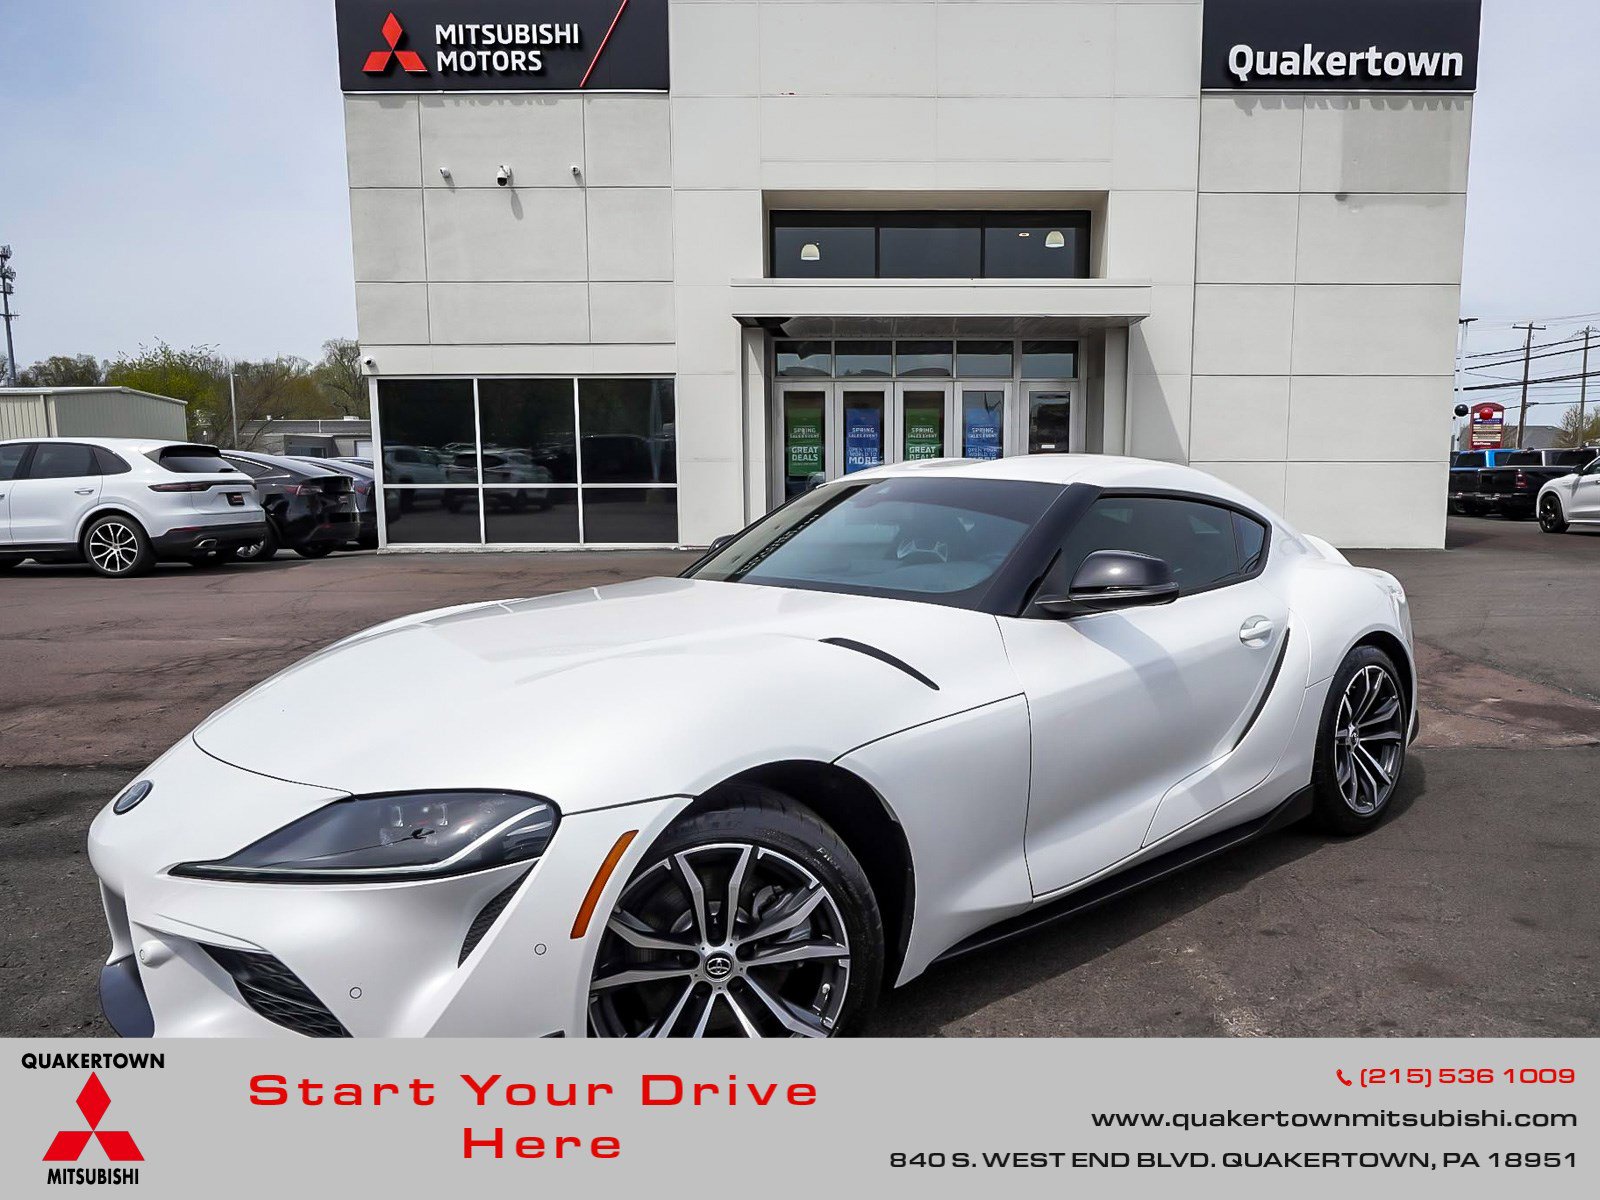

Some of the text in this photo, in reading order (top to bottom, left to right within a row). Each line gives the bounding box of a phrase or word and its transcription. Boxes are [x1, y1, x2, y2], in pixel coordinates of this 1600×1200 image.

[435, 23, 580, 45] MITSUBISHI
[437, 50, 543, 72] MOTORS
[1228, 43, 1464, 82] Quakertown
[791, 446, 819, 454] GREAT
[909, 446, 937, 454] GREAT
[849, 457, 878, 465] MORE
